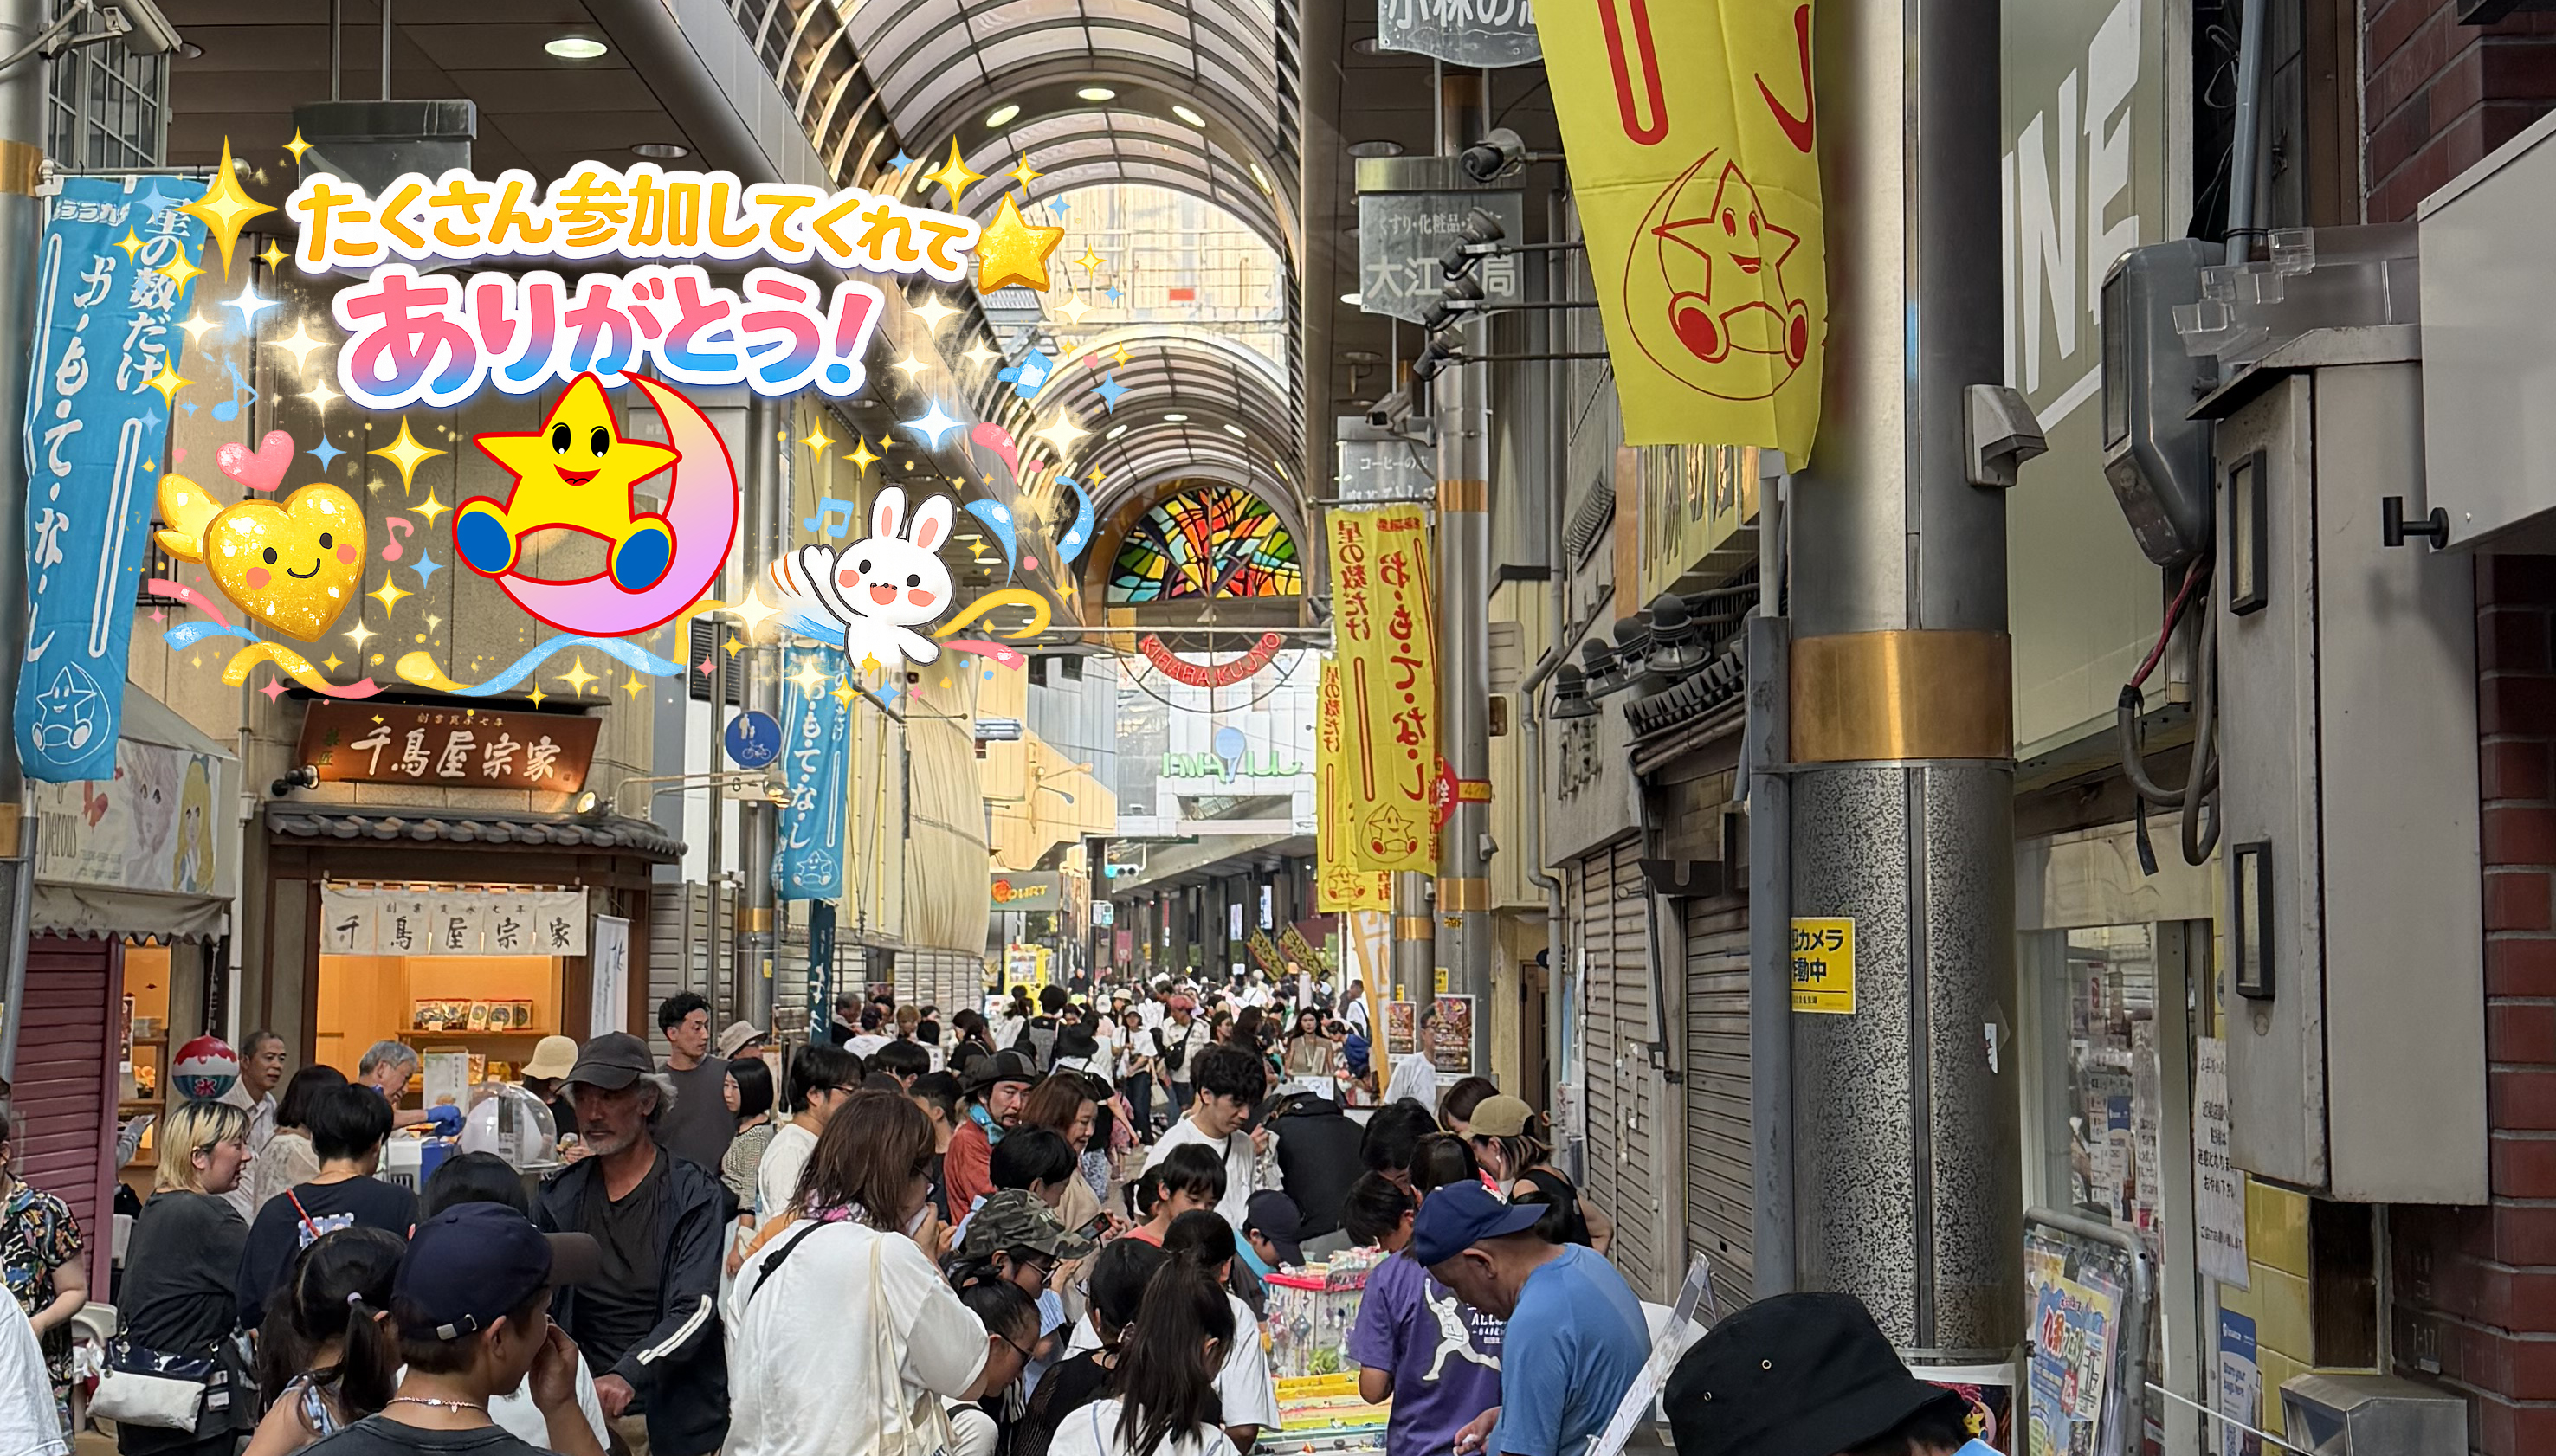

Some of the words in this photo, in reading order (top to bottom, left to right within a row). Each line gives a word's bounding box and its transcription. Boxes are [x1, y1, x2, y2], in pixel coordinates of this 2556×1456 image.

[1388, 0, 1538, 29] 小林の
[1379, 211, 1503, 235] くすり・化粧品・
[1366, 255, 1514, 298] 大江局
[1144, 635, 1210, 686] KIRARA
[1217, 632, 1281, 685] KUJYO
[351, 725, 561, 781] 千鳥屋宗家
[789, 668, 826, 849] ・も・て・な・し
[336, 915, 571, 950] 千鳥屋宗家
[1792, 957, 1827, 983] 動中
